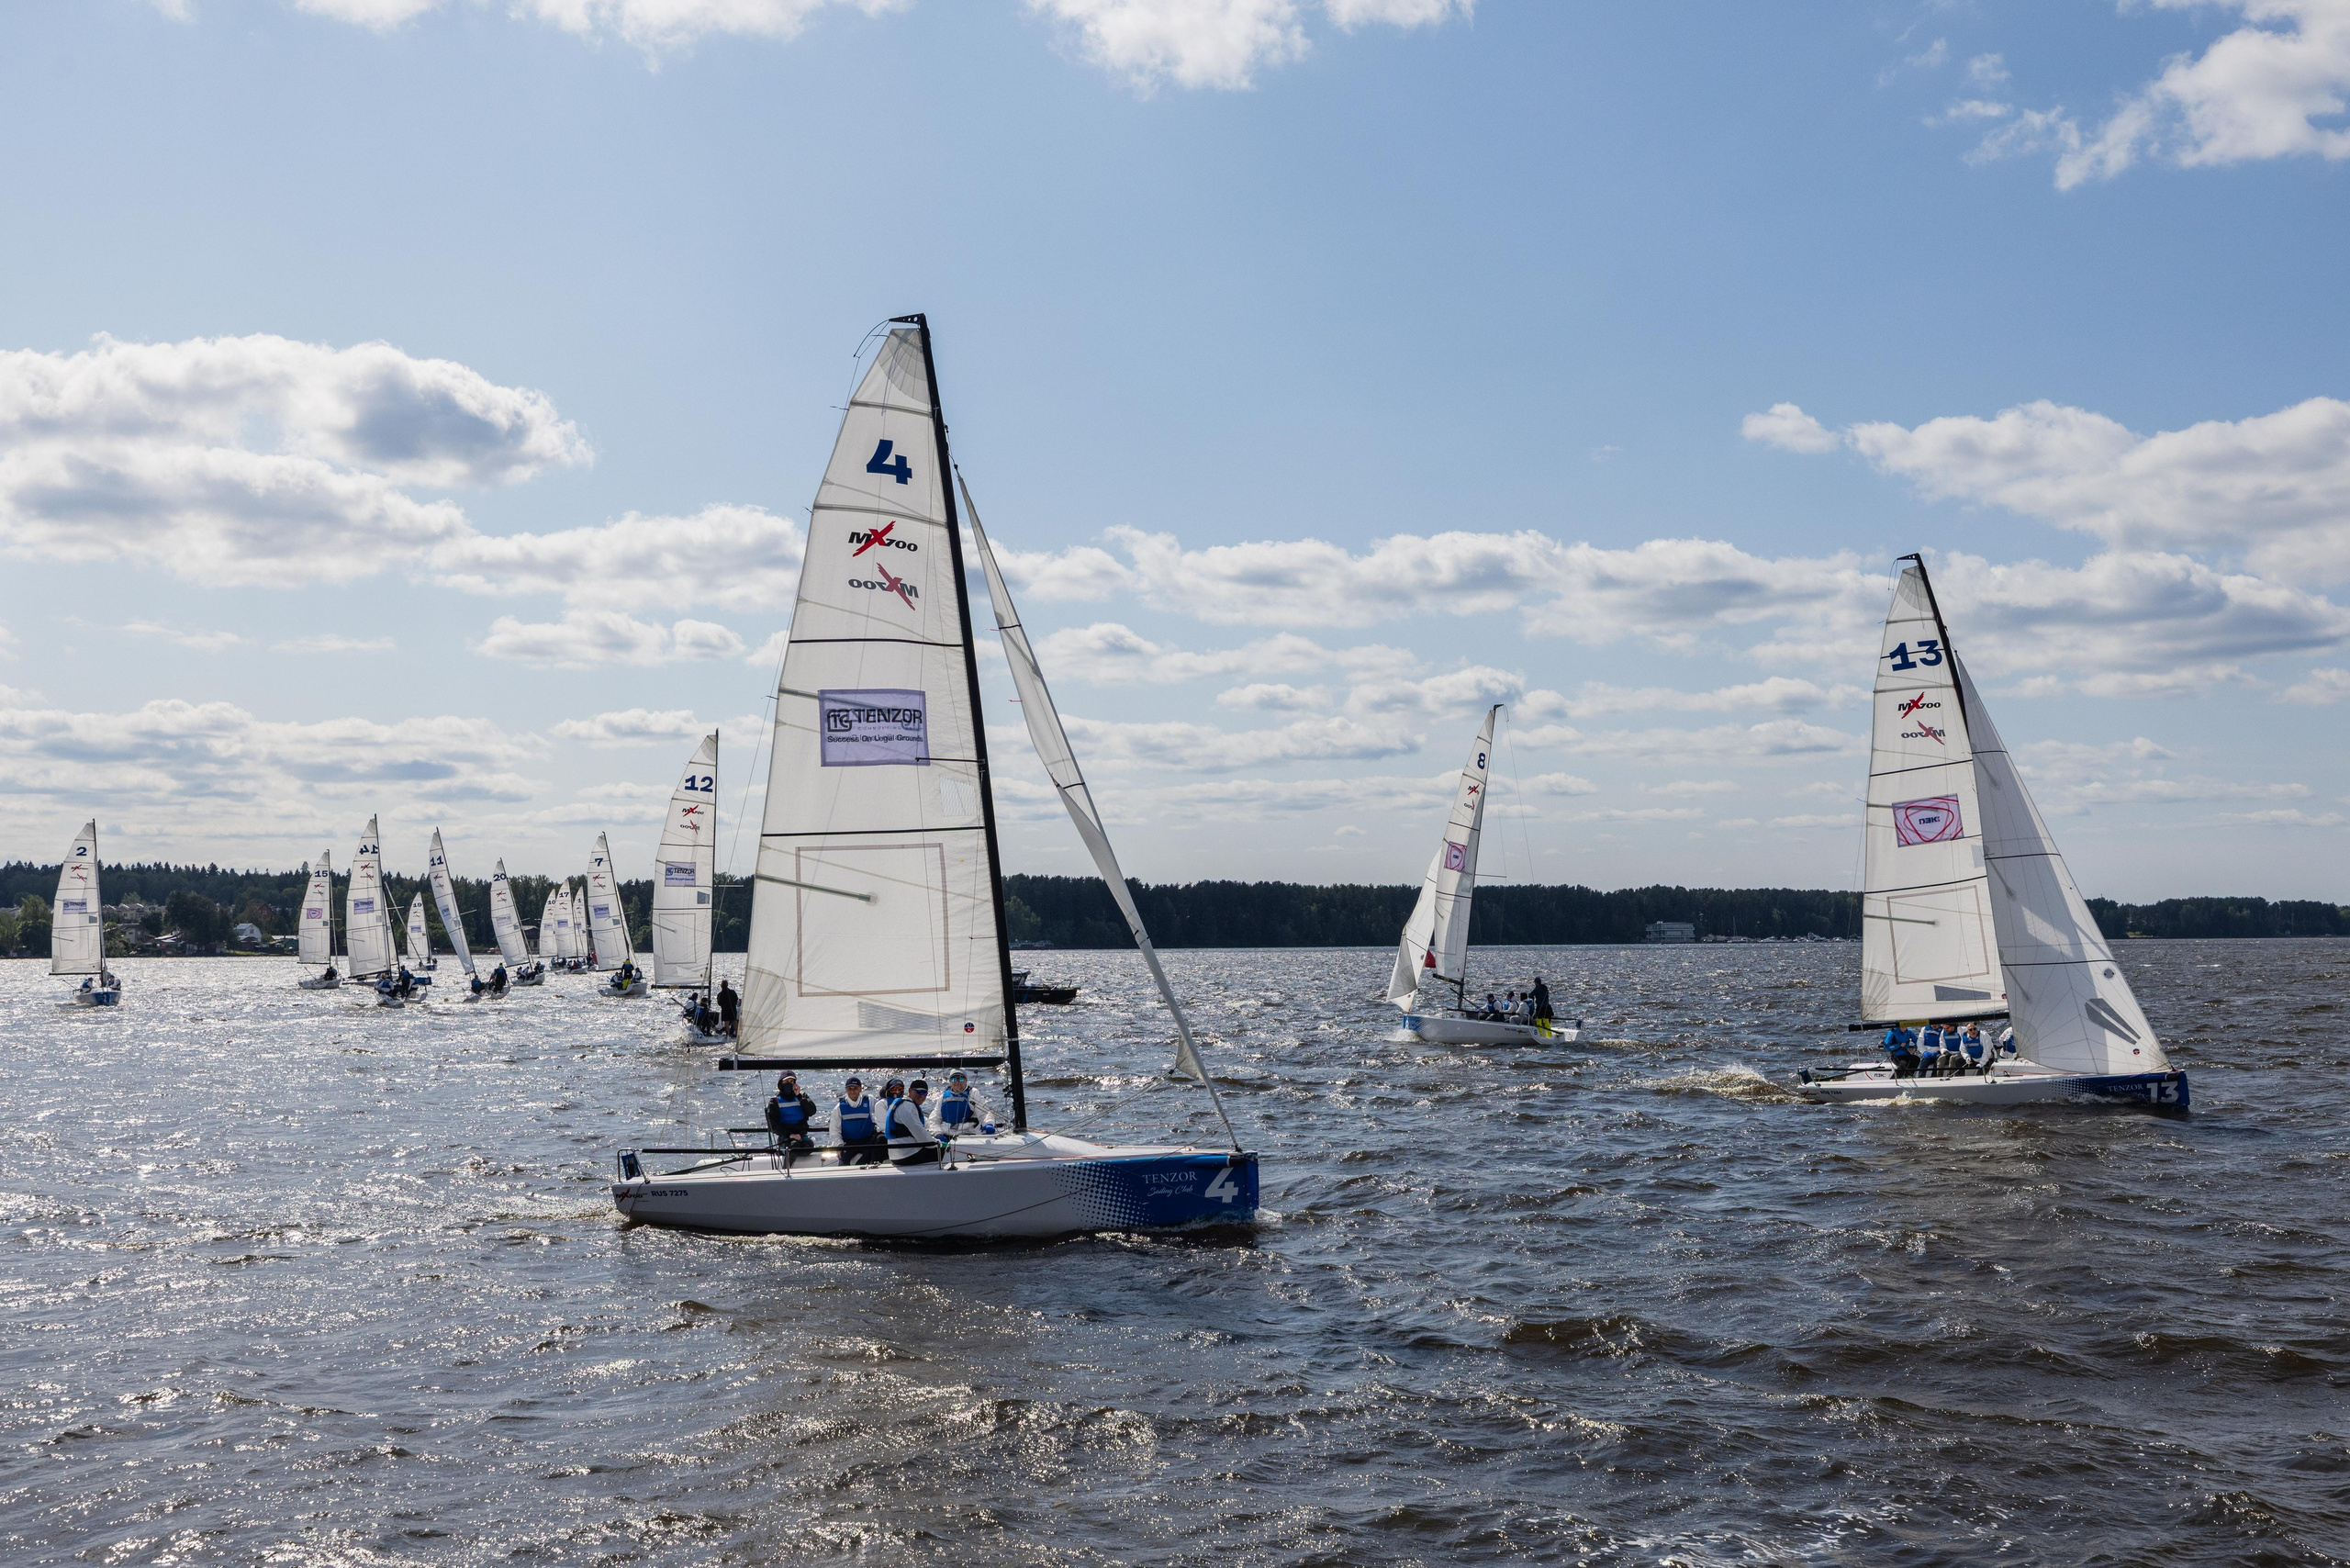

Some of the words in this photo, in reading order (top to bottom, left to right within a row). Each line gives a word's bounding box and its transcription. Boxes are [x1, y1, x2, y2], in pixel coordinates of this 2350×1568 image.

[866, 439, 912, 485] 4
[848, 521, 918, 557] MX700
[1889, 639, 1943, 671] 13
[1897, 691, 1941, 719] MX700
[854, 708, 923, 723] TENZOR
[875, 734, 894, 743] Legal
[897, 734, 923, 743] Grounds
[1477, 752, 1486, 769] 8
[684, 775, 714, 792] 12
[681, 804, 704, 817] MX700
[76, 846, 87, 857] 2
[430, 855, 444, 867] 11
[594, 857, 603, 867] 7
[314, 869, 328, 878] 15
[493, 873, 507, 882] 20
[2108, 1083, 2143, 1092] TENZOR
[2146, 1081, 2179, 1103] 13
[1142, 1170, 1198, 1184] TENZOR
[1147, 1186, 1173, 1197] Sailing
[1174, 1184, 1193, 1195] Club
[1204, 1168, 1239, 1204] 4
[615, 1187, 643, 1203] MX700
